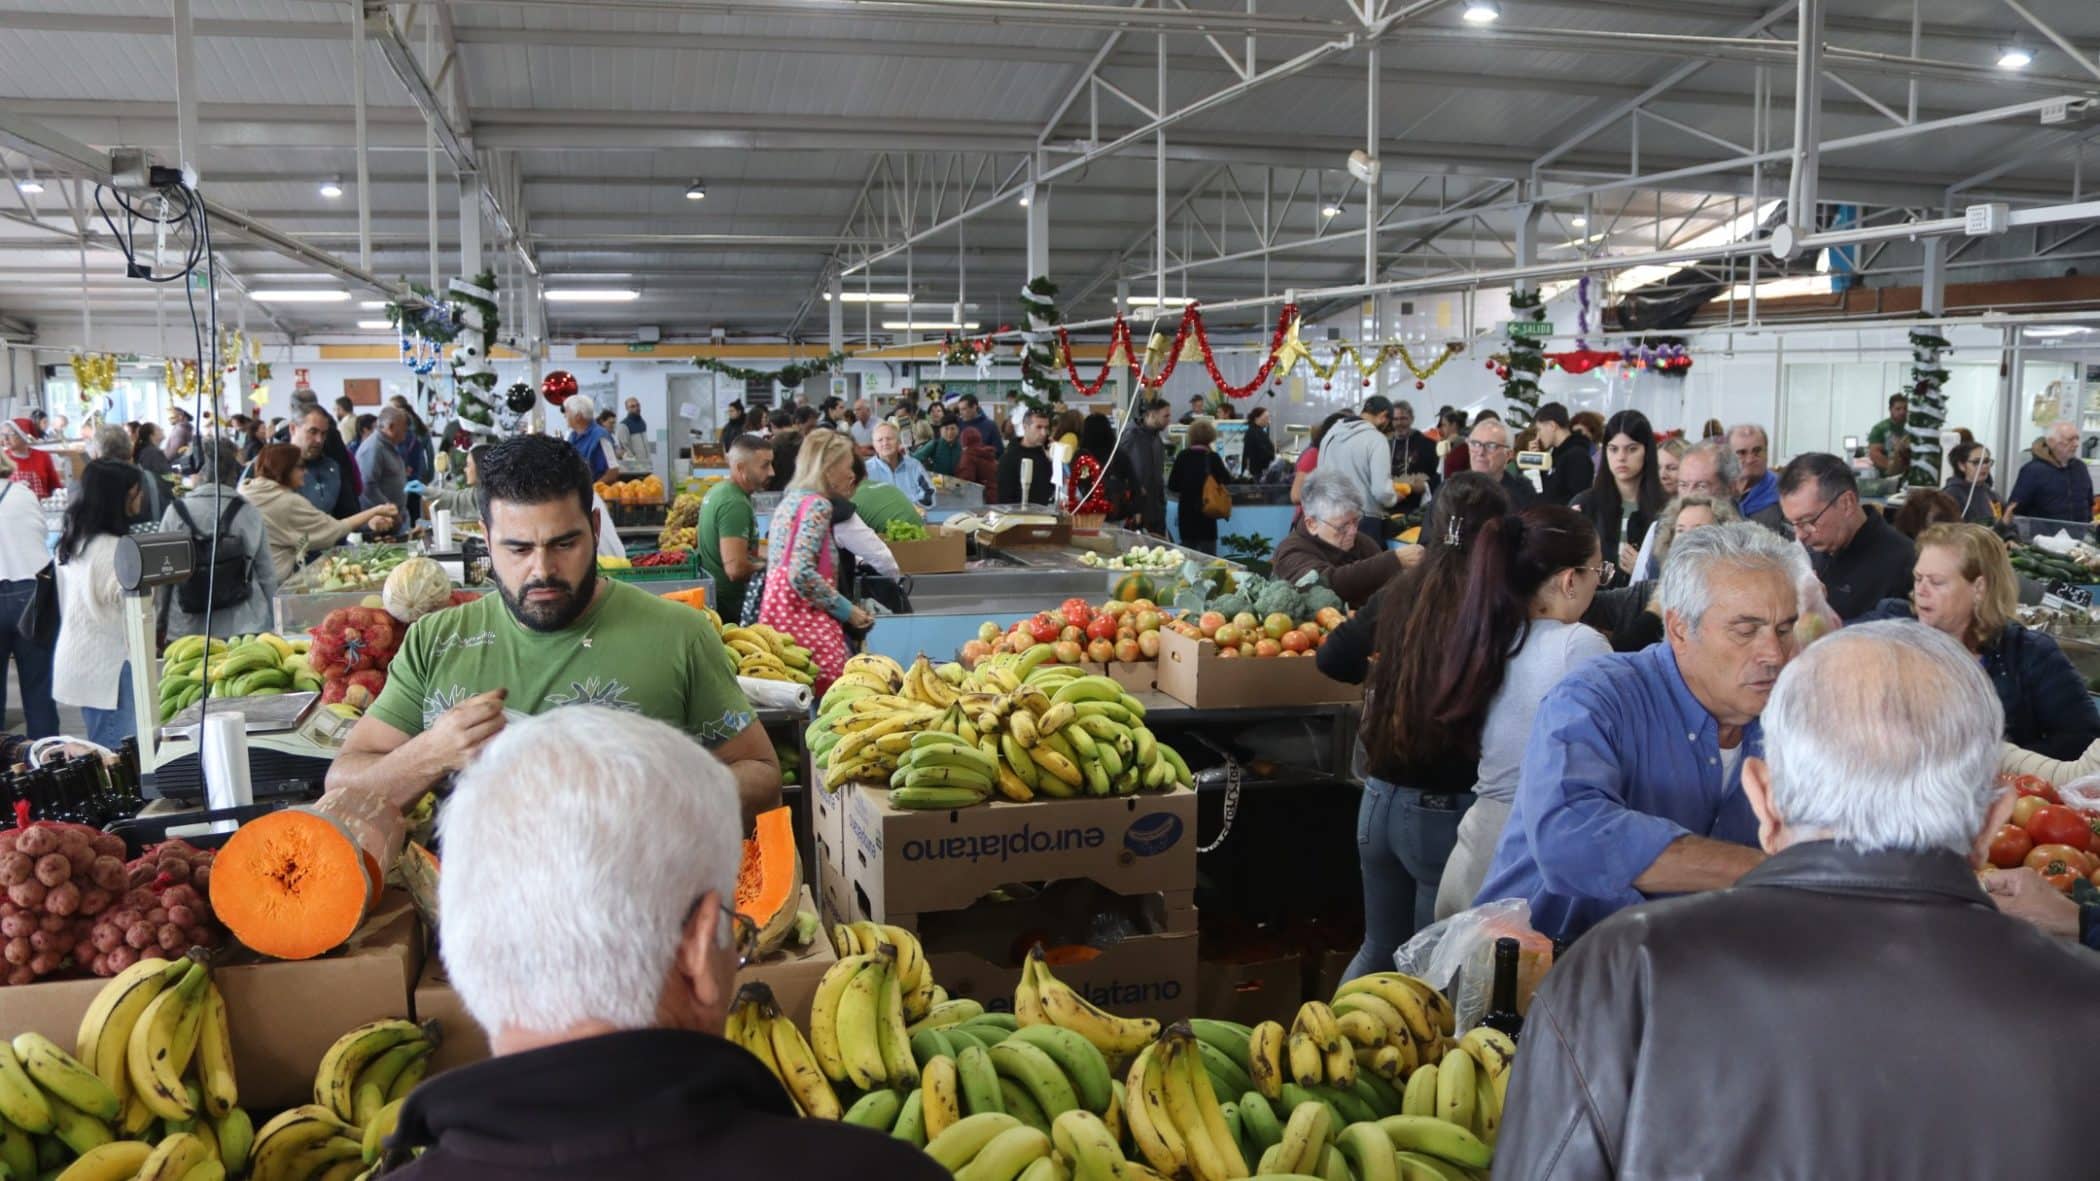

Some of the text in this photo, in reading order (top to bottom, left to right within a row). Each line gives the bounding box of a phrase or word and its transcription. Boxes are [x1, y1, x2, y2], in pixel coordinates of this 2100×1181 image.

[1522, 323, 1551, 334] SALIDA
[902, 823, 1105, 863] europlatano
[987, 979, 1182, 1012] elatano
